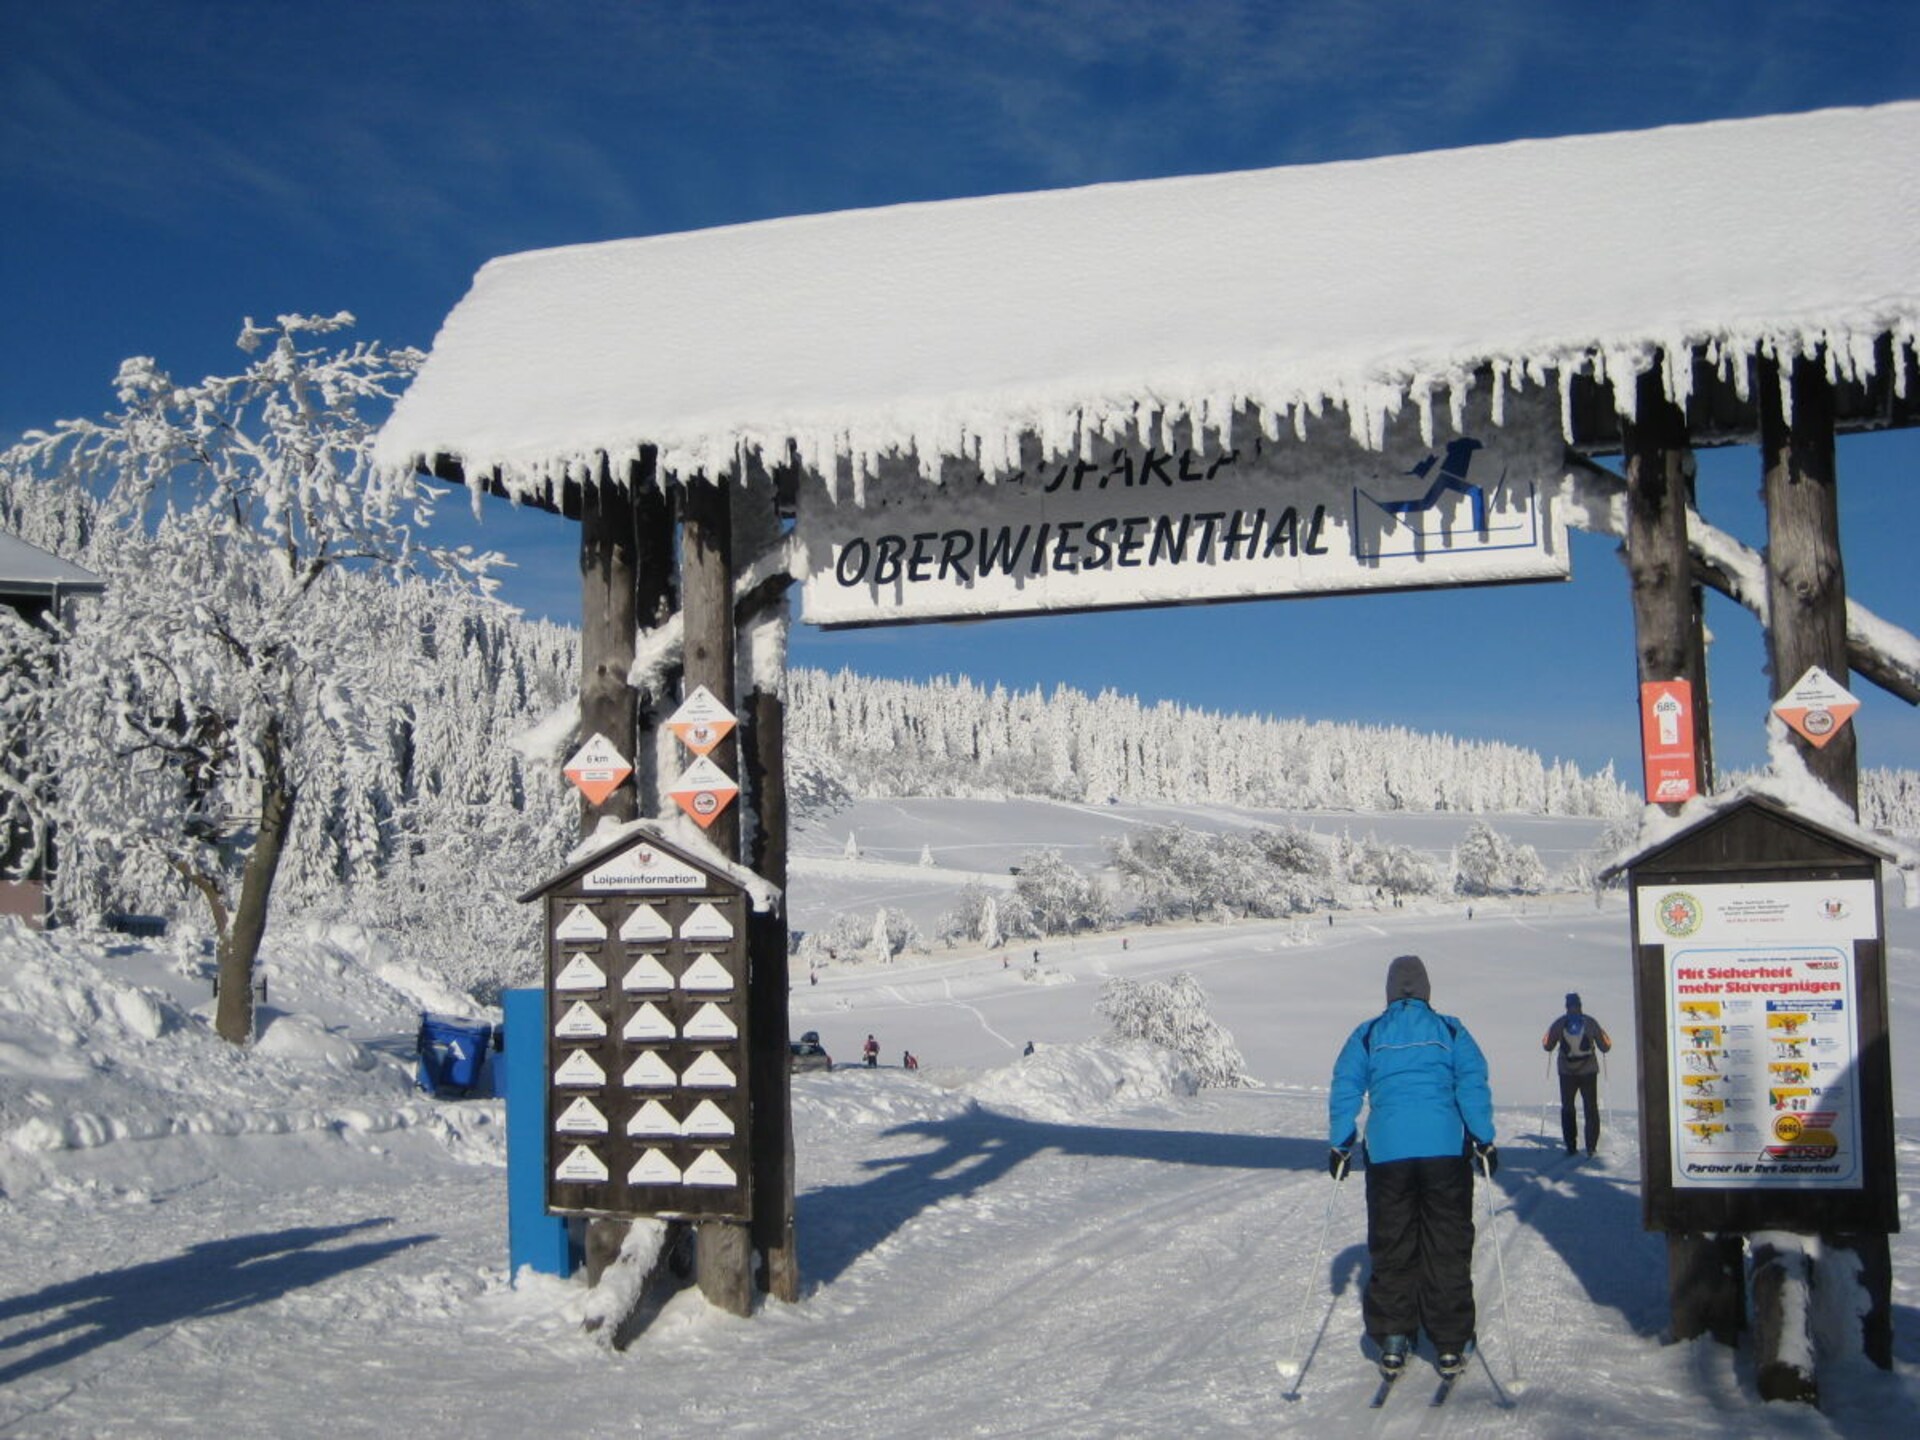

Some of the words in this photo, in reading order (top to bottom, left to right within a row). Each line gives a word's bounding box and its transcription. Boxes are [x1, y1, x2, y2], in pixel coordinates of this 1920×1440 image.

[836, 504, 1328, 587] OBERWIESENTHAL
[1656, 701, 1677, 712] 685
[594, 754, 609, 763] km
[593, 872, 698, 886] Loipeninformation
[1677, 967, 1704, 980] Mit
[1707, 966, 1793, 979] Sicherheit
[1678, 982, 1723, 995] mehr
[1725, 979, 1841, 995] Skivergnügen
[1686, 1163, 1732, 1173] Partner
[1733, 1163, 1754, 1173] für
[1754, 1162, 1778, 1173] Ihre
[1779, 1162, 1840, 1174] Sicherheit
